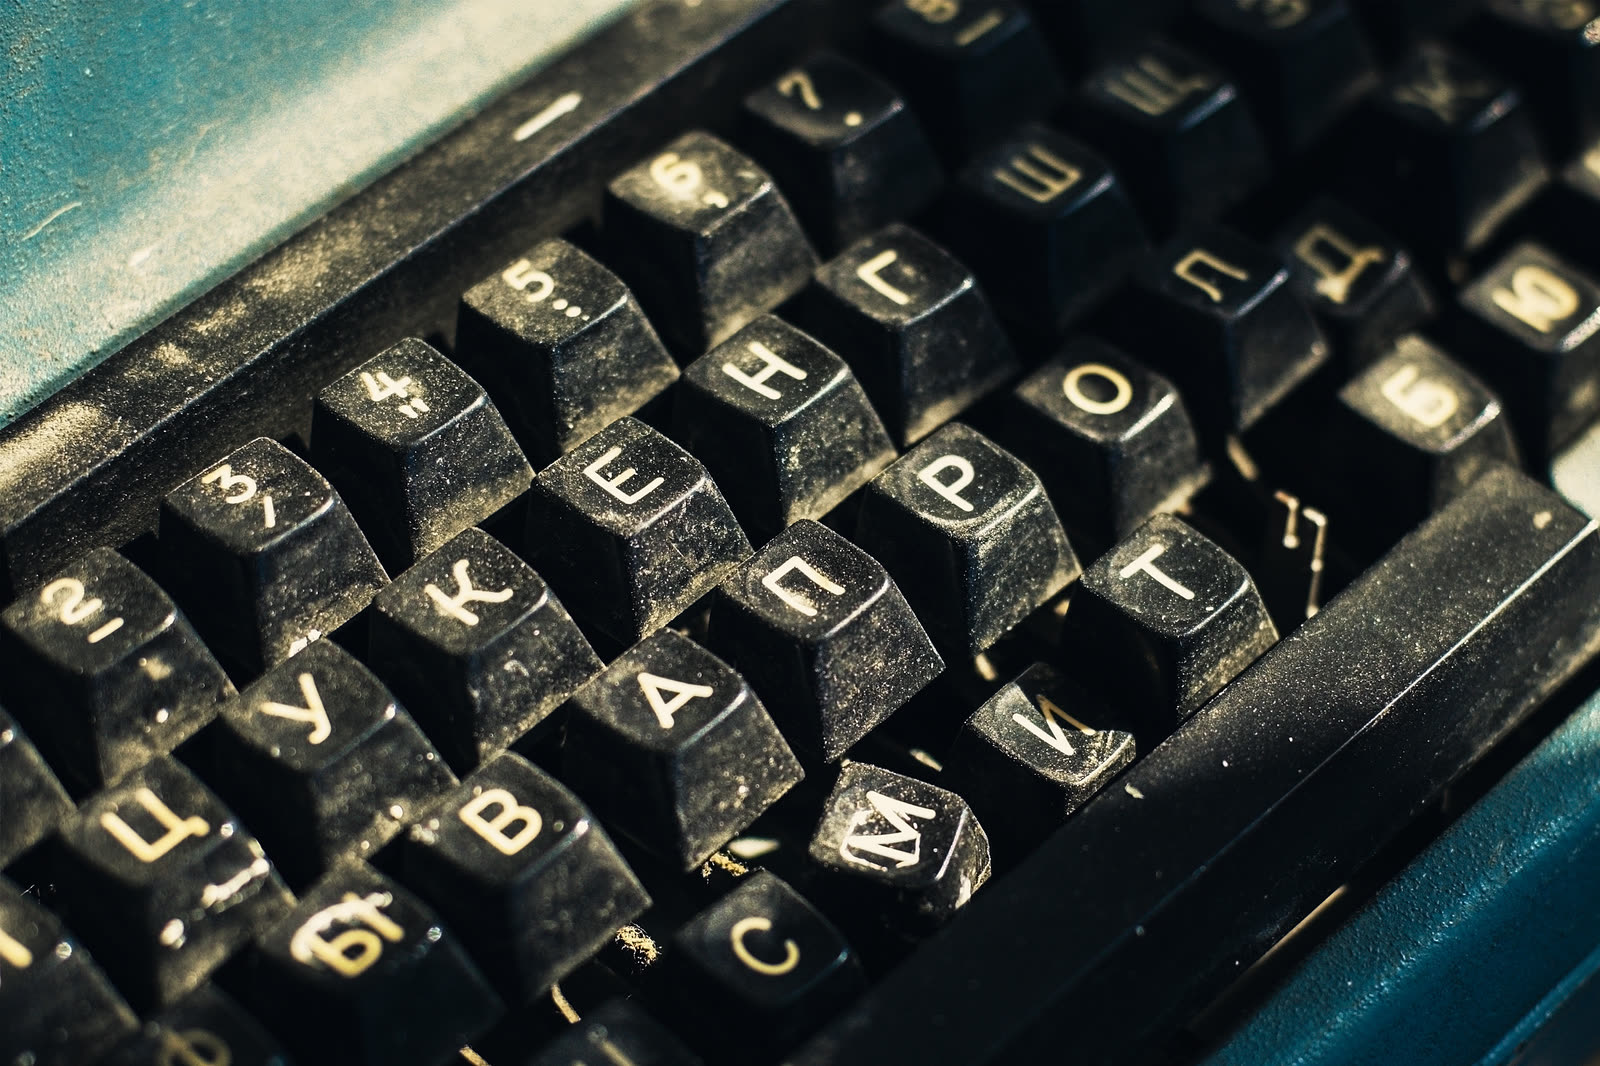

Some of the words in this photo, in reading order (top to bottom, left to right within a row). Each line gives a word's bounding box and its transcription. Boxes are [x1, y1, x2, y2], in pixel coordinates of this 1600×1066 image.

[778, 70, 821, 110] 7
[649, 152, 701, 197] 6
[993, 144, 1083, 203] Ш
[502, 258, 556, 303] 5
[856, 249, 911, 305] Г
[1173, 249, 1249, 302] Л
[1295, 225, 1386, 304] Д
[1491, 264, 1581, 334] Ю
[361, 371, 413, 403] 4
[721, 340, 808, 400] Н
[1062, 363, 1133, 415] О
[1381, 364, 1459, 428] Б
[201, 464, 259, 505] 3
[582, 447, 665, 505] Е
[918, 454, 976, 513] Р
[41, 577, 103, 625] 2
[424, 558, 515, 627] К
[761, 554, 846, 617] П
[1119, 543, 1196, 601] Т
[258, 672, 332, 745] У
[636, 671, 714, 729] А
[1011, 692, 1096, 757] И
[101, 787, 211, 863] Ц
[457, 788, 543, 856] В
[840, 789, 937, 870] М
[290, 890, 405, 979] Ы
[730, 916, 801, 976] С
